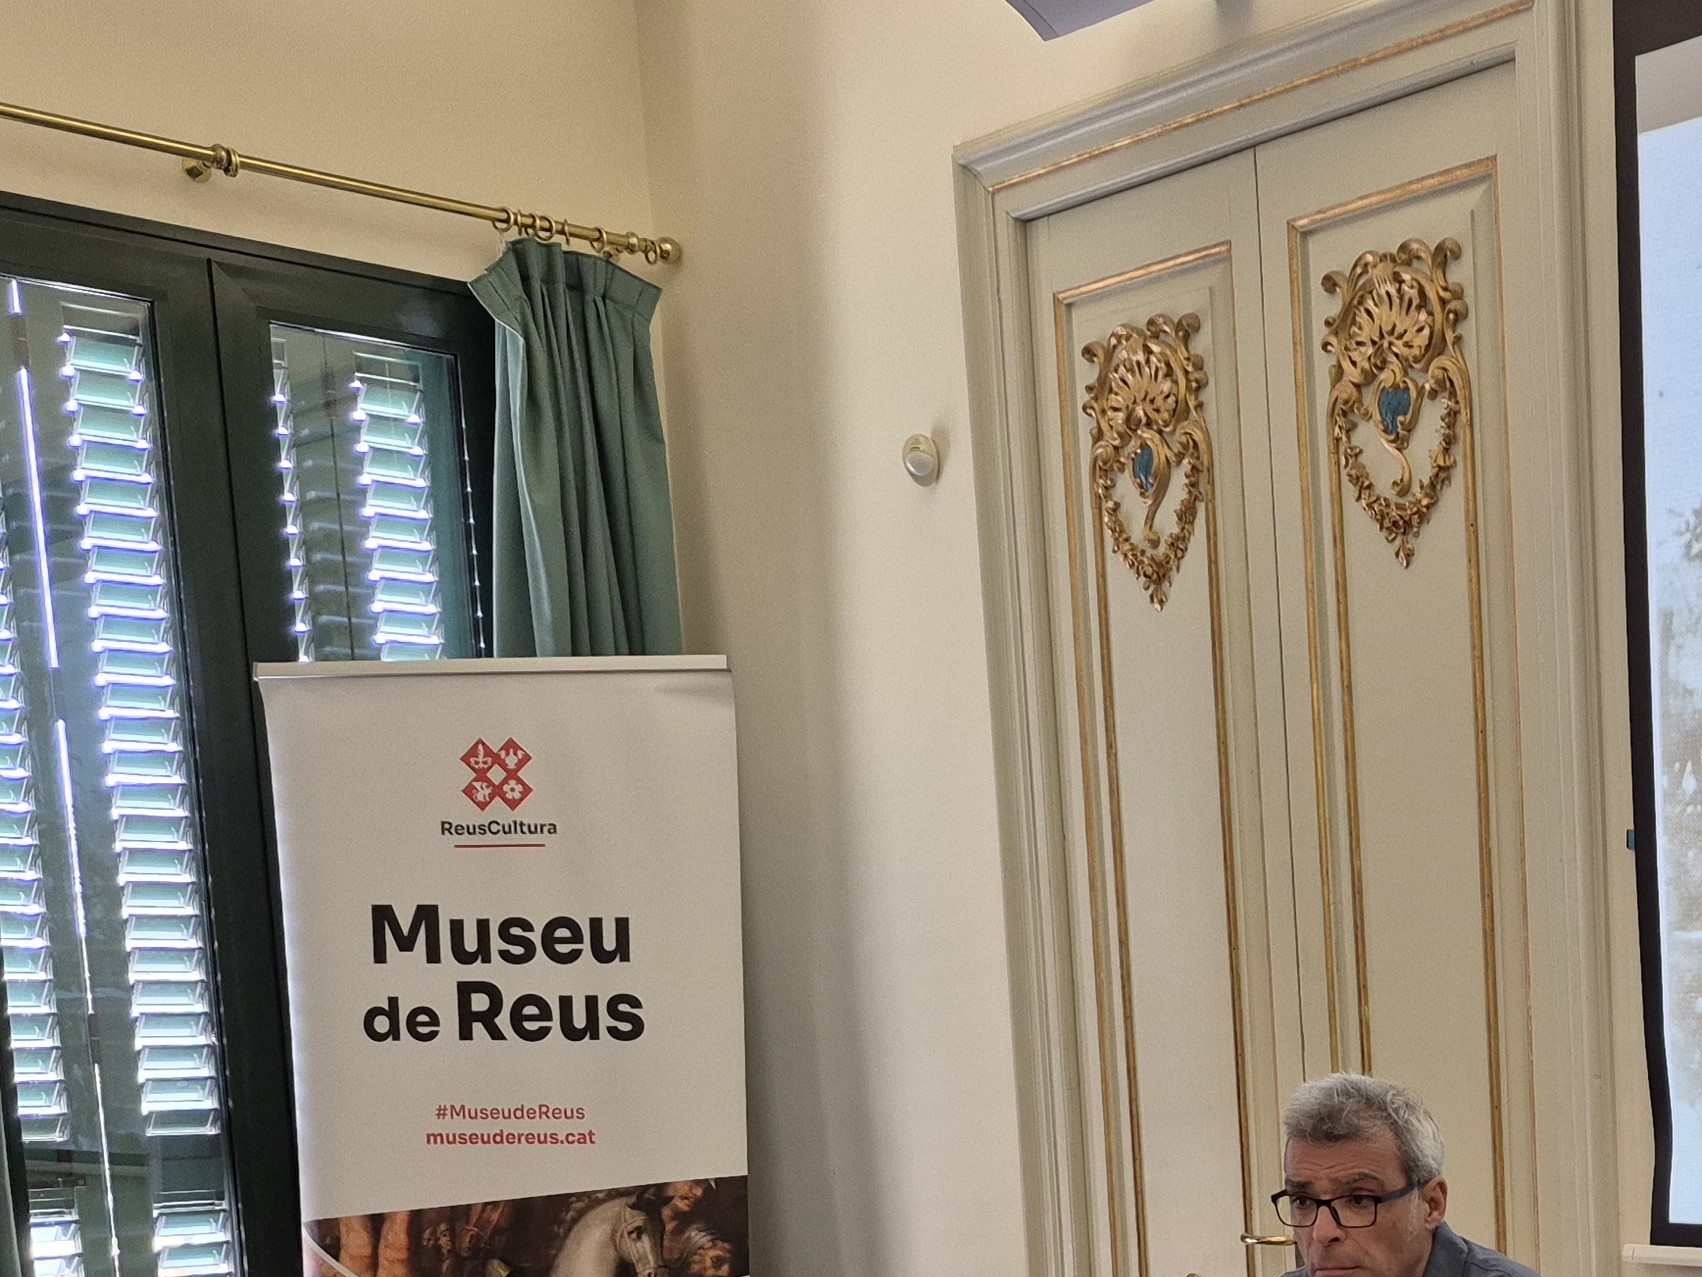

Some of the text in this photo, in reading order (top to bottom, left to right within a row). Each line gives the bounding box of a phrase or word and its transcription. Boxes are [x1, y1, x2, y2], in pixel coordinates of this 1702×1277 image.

[440, 819, 558, 836] ReusCultura
[371, 904, 632, 967] Museu
[363, 980, 646, 1043] de Reus
[435, 1103, 586, 1122] #MuseudeReus
[426, 1129, 597, 1147] museudereus.cat
